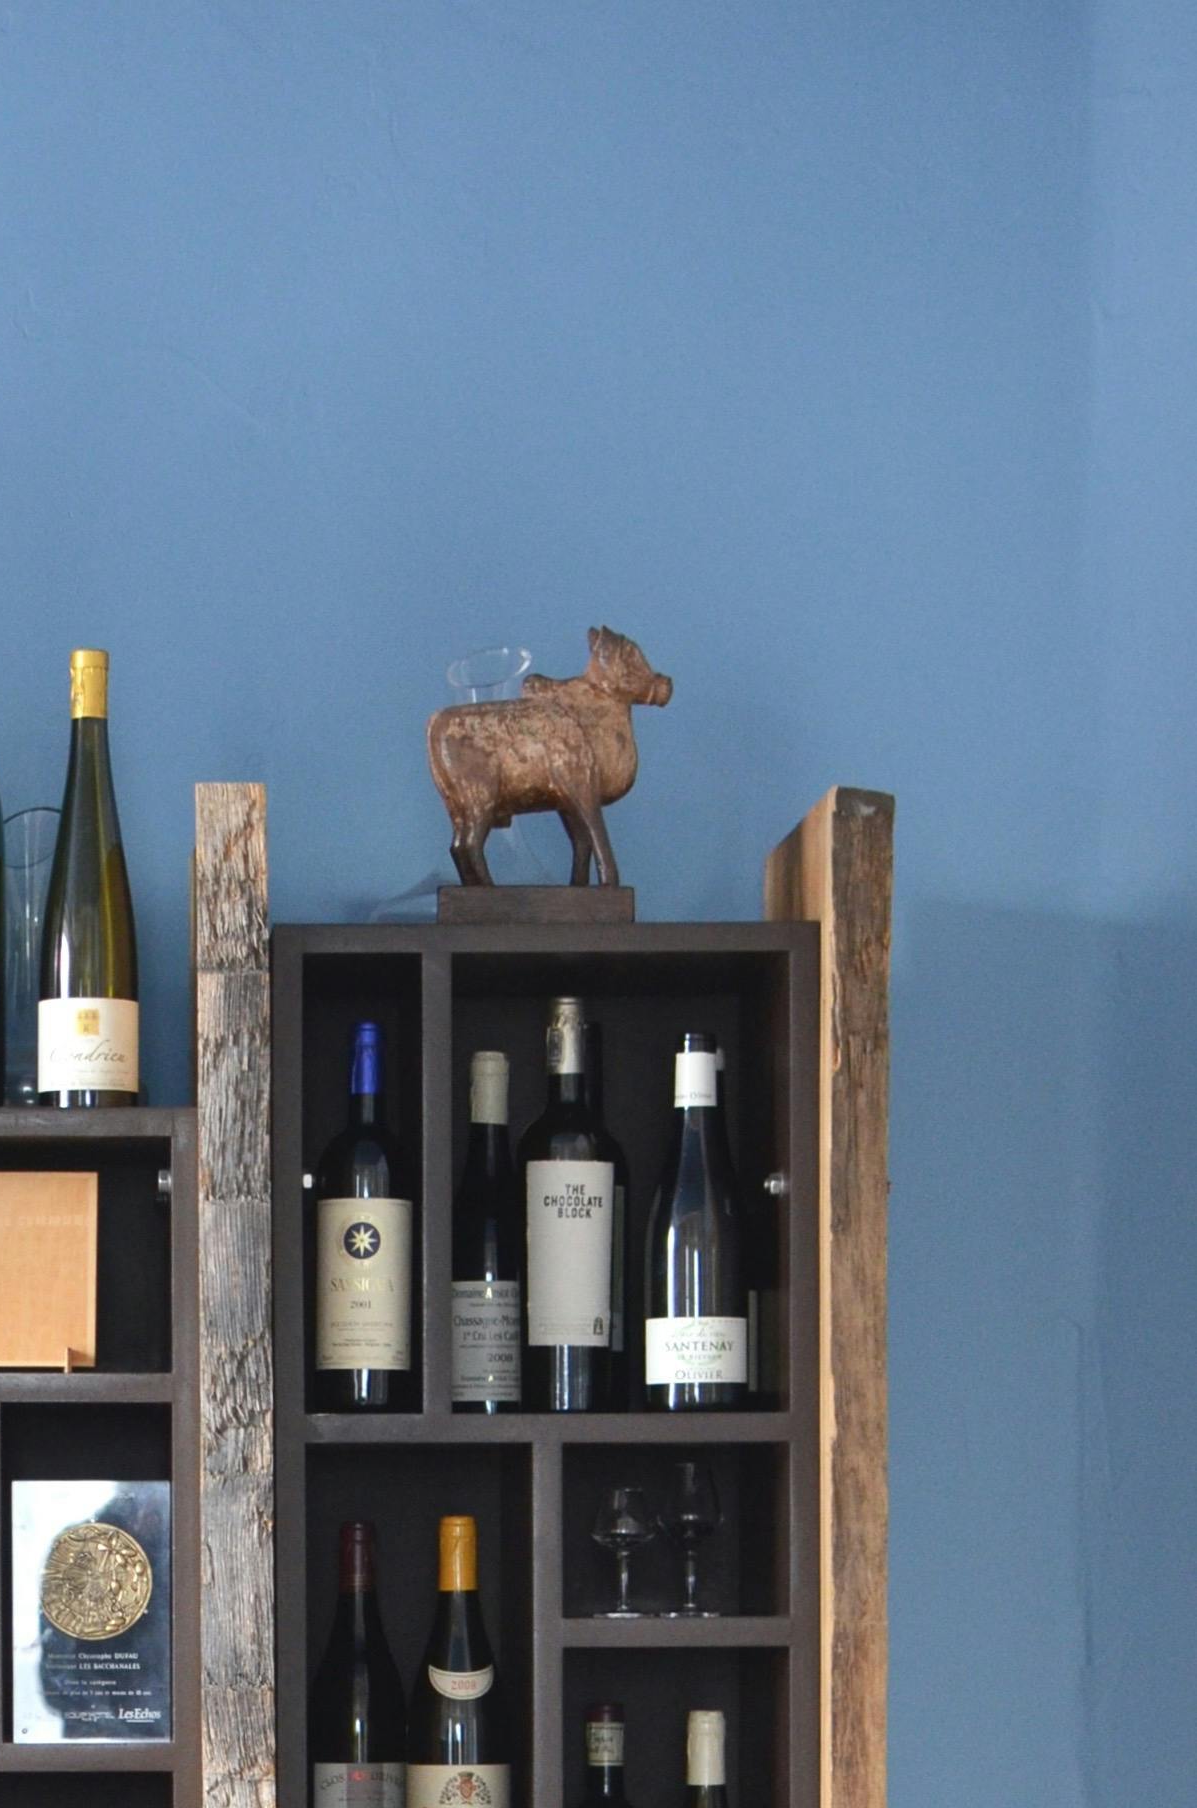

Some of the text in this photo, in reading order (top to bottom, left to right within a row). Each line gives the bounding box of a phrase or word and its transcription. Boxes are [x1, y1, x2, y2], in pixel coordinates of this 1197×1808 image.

[565, 1184, 586, 1195] THE
[543, 1196, 603, 1208] CHOCOLATE
[557, 1207, 592, 1219] BLOCK
[665, 1341, 733, 1352] SANTENAY
